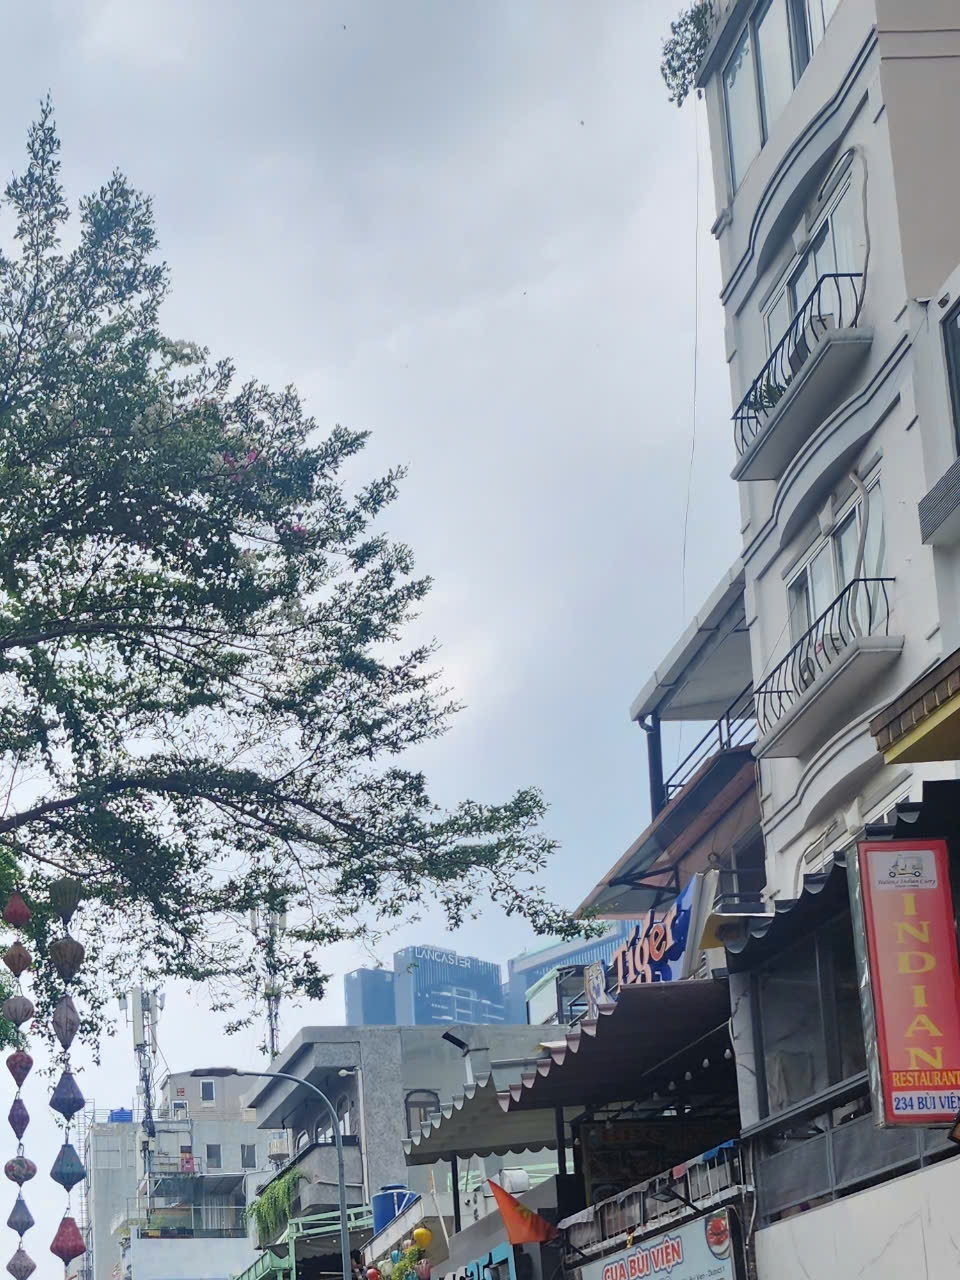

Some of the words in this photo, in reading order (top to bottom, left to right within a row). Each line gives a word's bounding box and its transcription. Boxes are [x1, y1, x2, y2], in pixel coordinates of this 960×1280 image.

[415, 946, 471, 969] LANCASTER
[611, 901, 679, 995] Tiger
[894, 892, 945, 1070] INDIAN
[894, 1096, 914, 1111] 234
[917, 1092, 937, 1110] BÙI
[627, 1248, 650, 1279] BÙI
[650, 1237, 683, 1271] VIỆN
